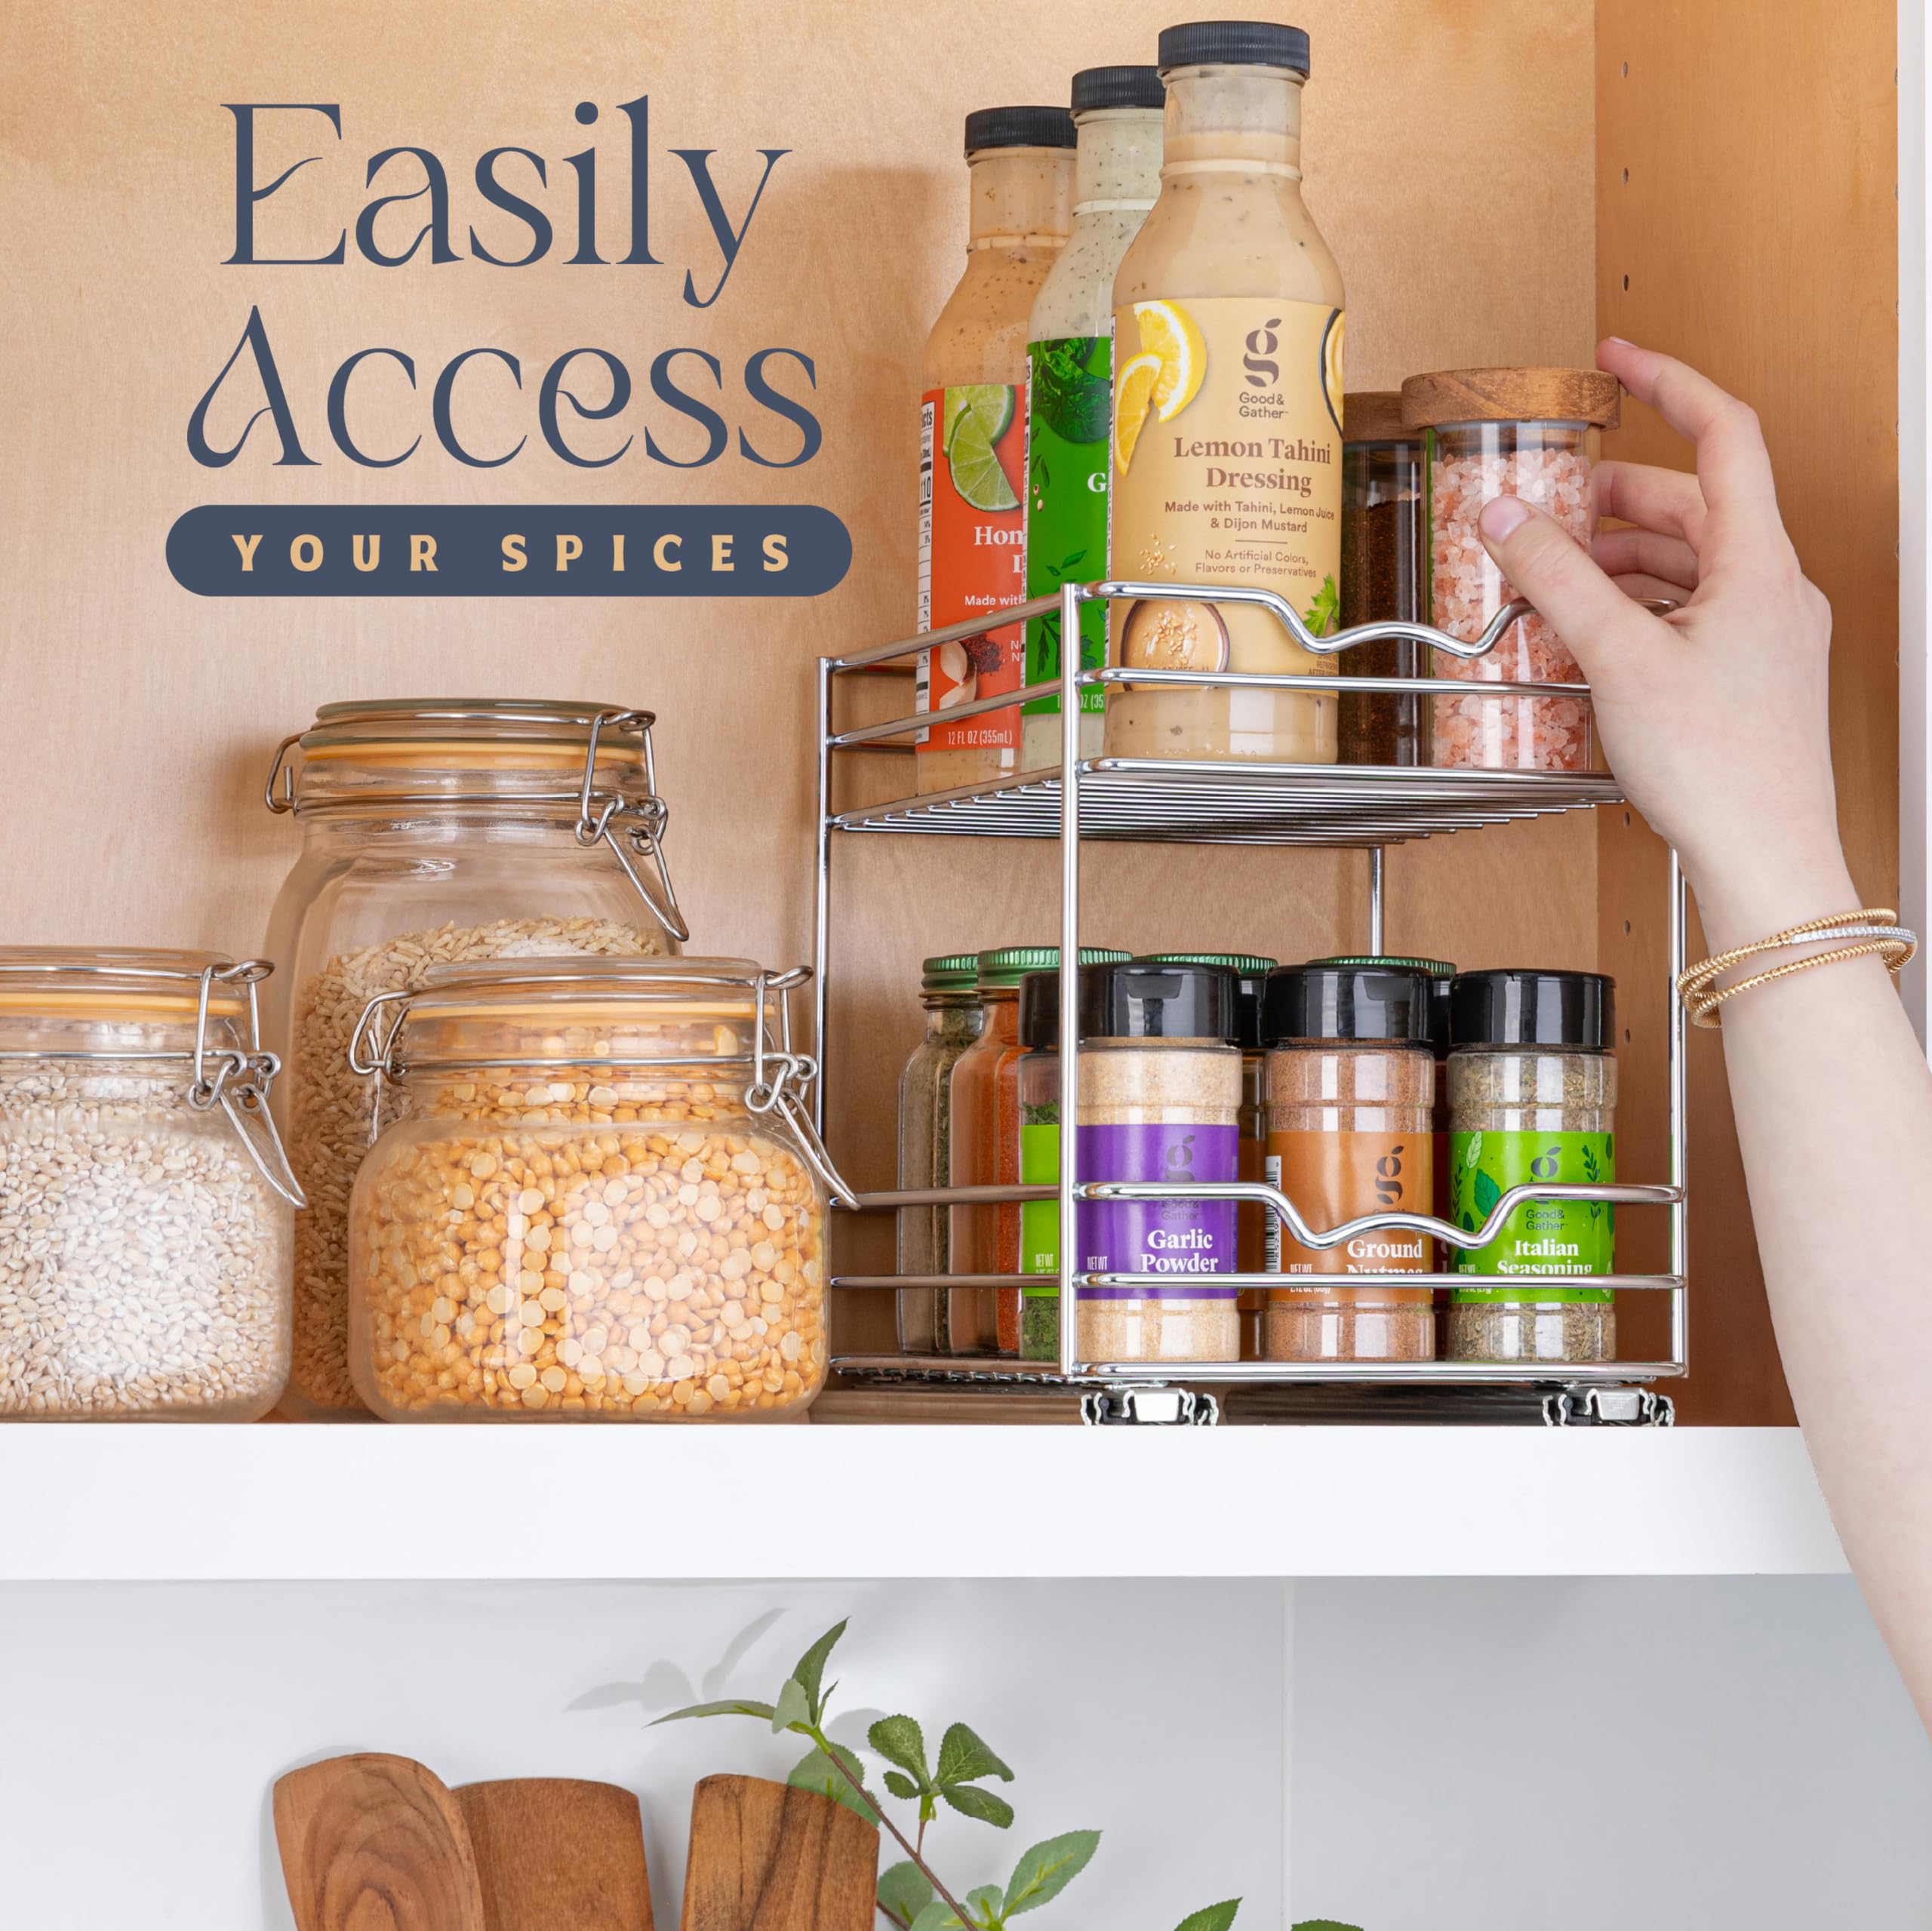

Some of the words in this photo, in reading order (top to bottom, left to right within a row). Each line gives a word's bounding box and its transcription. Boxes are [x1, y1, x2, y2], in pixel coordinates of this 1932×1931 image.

[1174, 437, 1263, 458] Lemon
[1268, 438, 1331, 465] Tahini
[1087, 472, 1108, 493] G
[1205, 467, 1312, 498] Dressing
[1164, 501, 1199, 512] Made
[1203, 501, 1231, 512] with
[1235, 501, 1277, 515] Tahini,
[1280, 503, 1314, 517] Lemon
[1315, 507, 1335, 521] Juice
[1210, 518, 1220, 528] &
[1223, 518, 1257, 530] Dijon
[1261, 518, 1308, 533] Mustard
[974, 526, 1023, 546] Hon
[1204, 549, 1221, 560] No
[1224, 550, 1272, 561] Artificial
[1275, 552, 1309, 565] Colors,
[1195, 562, 1235, 573] Flavors
[1239, 564, 1251, 573] or
[1254, 563, 1317, 579] Preservatives
[964, 594, 996, 606] Made
[1090, 693, 1105, 710] (35
[948, 730, 955, 746] 12
[957, 730, 965, 745] FL
[968, 730, 978, 745] OZ
[979, 730, 1013, 746] (355mL)
[1526, 1209, 1564, 1219] Good&
[1147, 1228, 1213, 1250] Garlic
[1514, 1238, 1580, 1257] Italian
[1347, 1239, 1423, 1259] Ground
[1140, 1253, 1219, 1273] Powder
[1497, 1259, 1593, 1274] Seasoning
